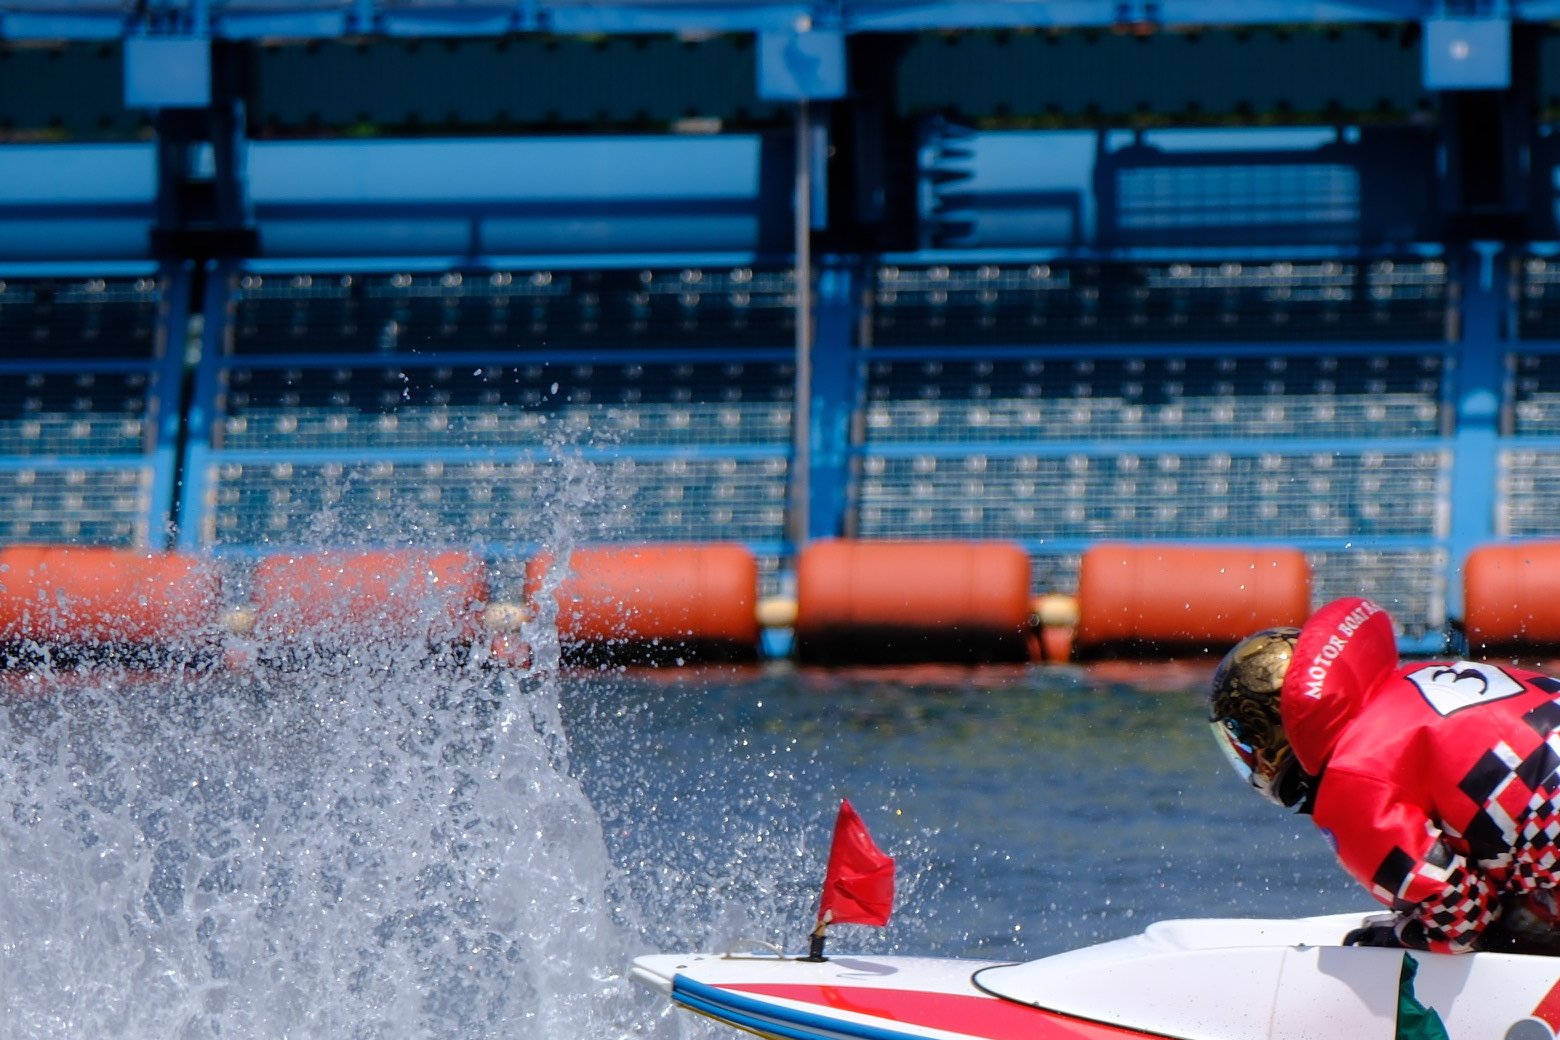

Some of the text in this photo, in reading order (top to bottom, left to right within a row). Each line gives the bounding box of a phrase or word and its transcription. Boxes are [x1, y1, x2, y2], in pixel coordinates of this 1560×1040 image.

[1304, 635, 1348, 700] MOTOR
[1338, 606, 1370, 638] BOAT
[1432, 668, 1488, 695] 3
